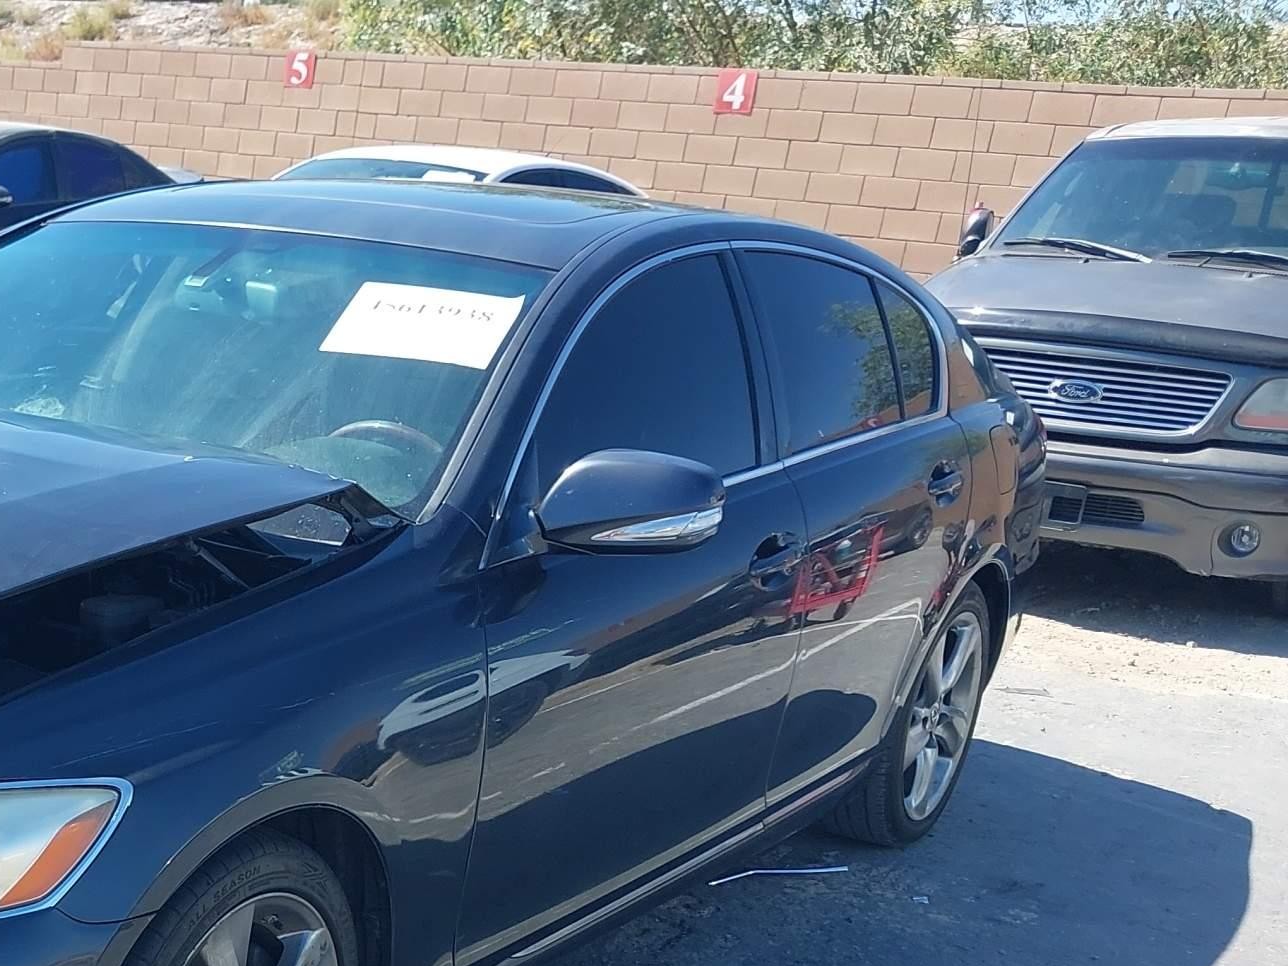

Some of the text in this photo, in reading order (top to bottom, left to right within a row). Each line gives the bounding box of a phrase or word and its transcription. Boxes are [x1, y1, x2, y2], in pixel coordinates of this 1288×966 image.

[289, 52, 309, 85] 5
[722, 73, 746, 110] 4
[213, 864, 261, 903] SEASON
